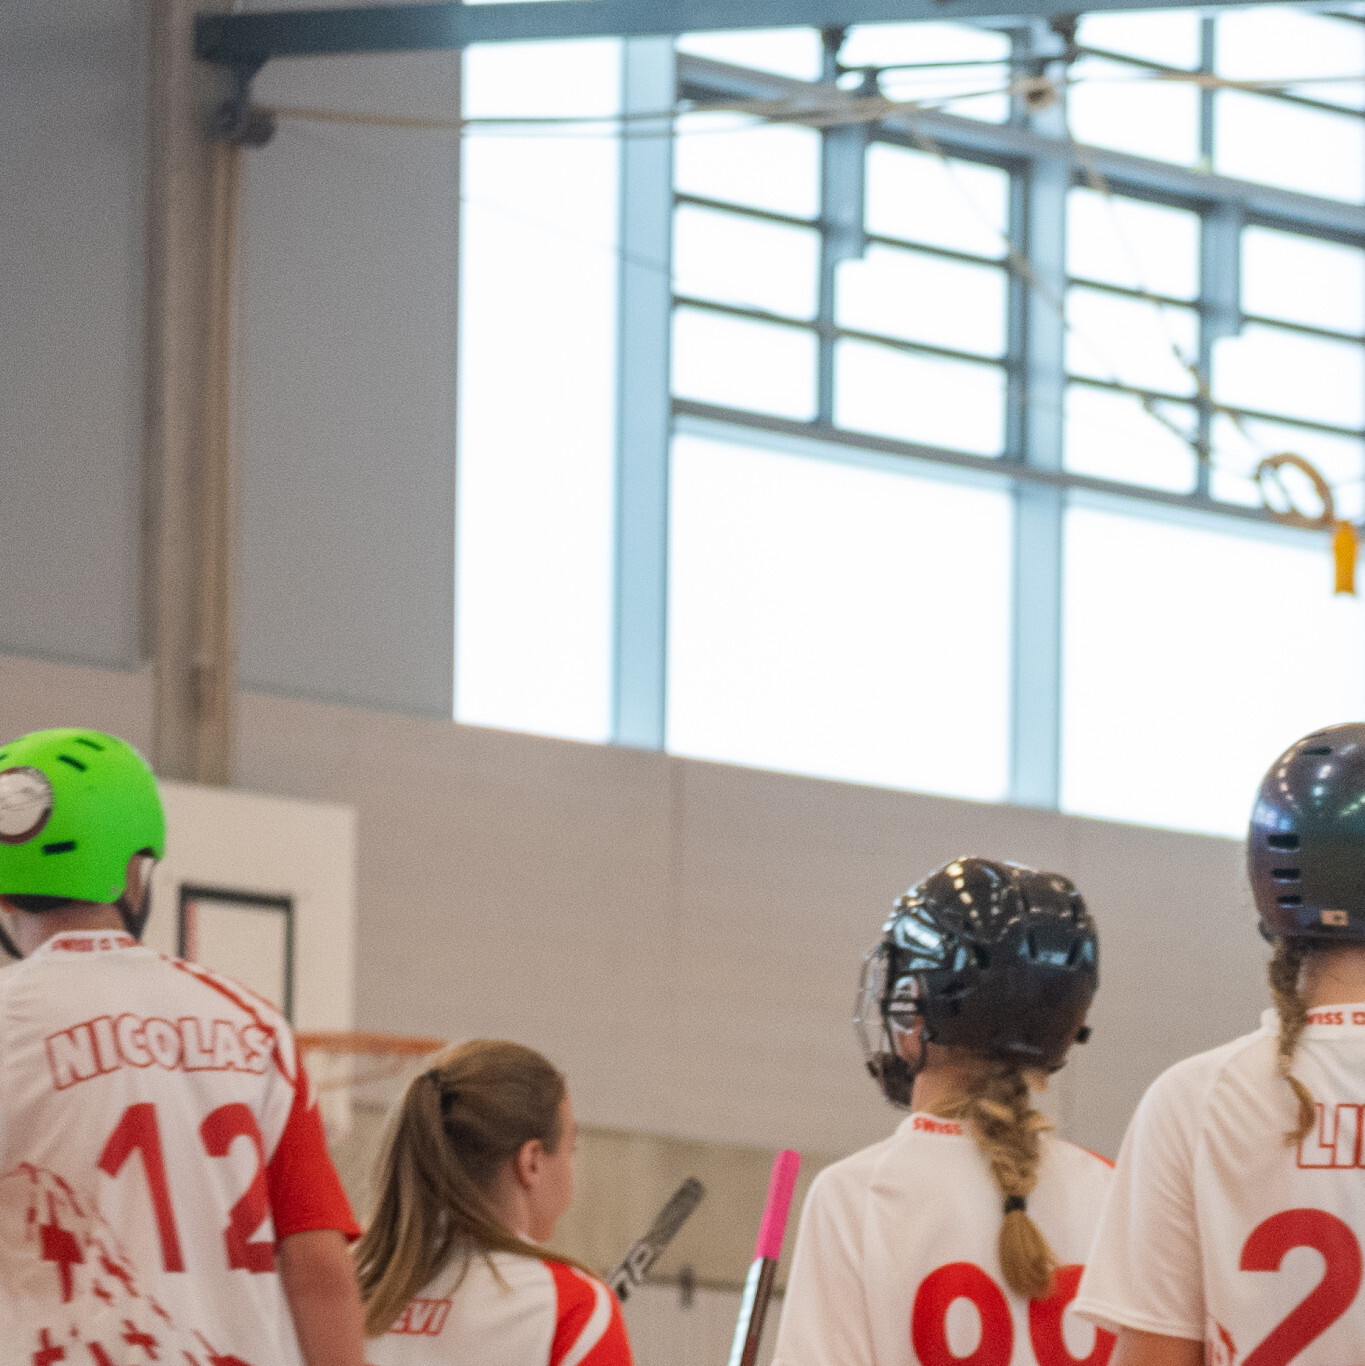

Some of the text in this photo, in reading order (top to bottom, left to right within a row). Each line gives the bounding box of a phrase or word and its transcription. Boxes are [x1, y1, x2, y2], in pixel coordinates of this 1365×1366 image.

[45, 1012, 275, 1091] NICOLAS
[1306, 1010, 1344, 1026] WISS
[97, 1102, 276, 1274] 12
